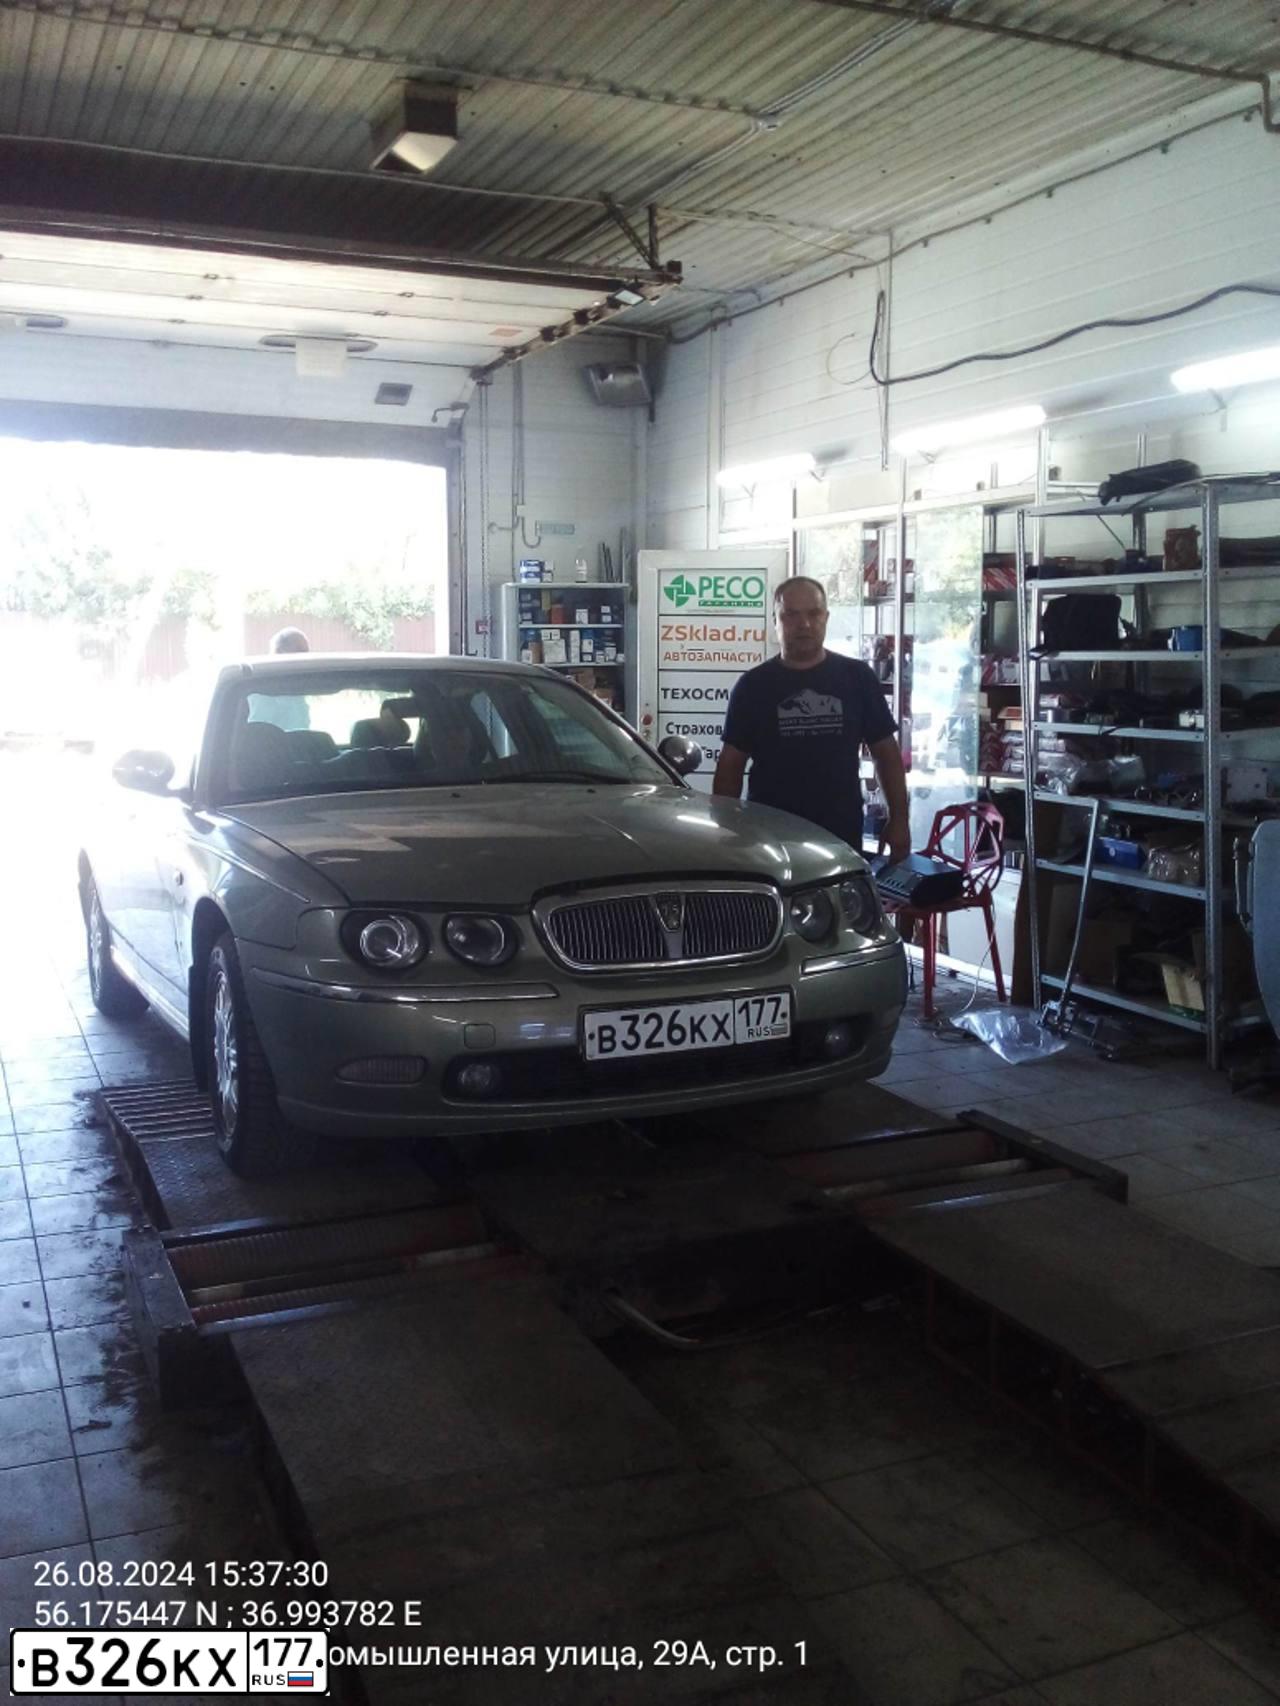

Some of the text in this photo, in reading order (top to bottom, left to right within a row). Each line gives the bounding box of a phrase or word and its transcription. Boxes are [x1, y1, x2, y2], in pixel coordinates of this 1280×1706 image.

[699, 576, 764, 599] РЕСО
[661, 624, 766, 642] ZSklad.ru
[663, 652, 762, 662] АВТОЗАПЧАСТИ
[660, 688, 729, 700] ТЕХОСМ
[738, 997, 782, 1027] 177
[747, 1026, 770, 1038] RUS
